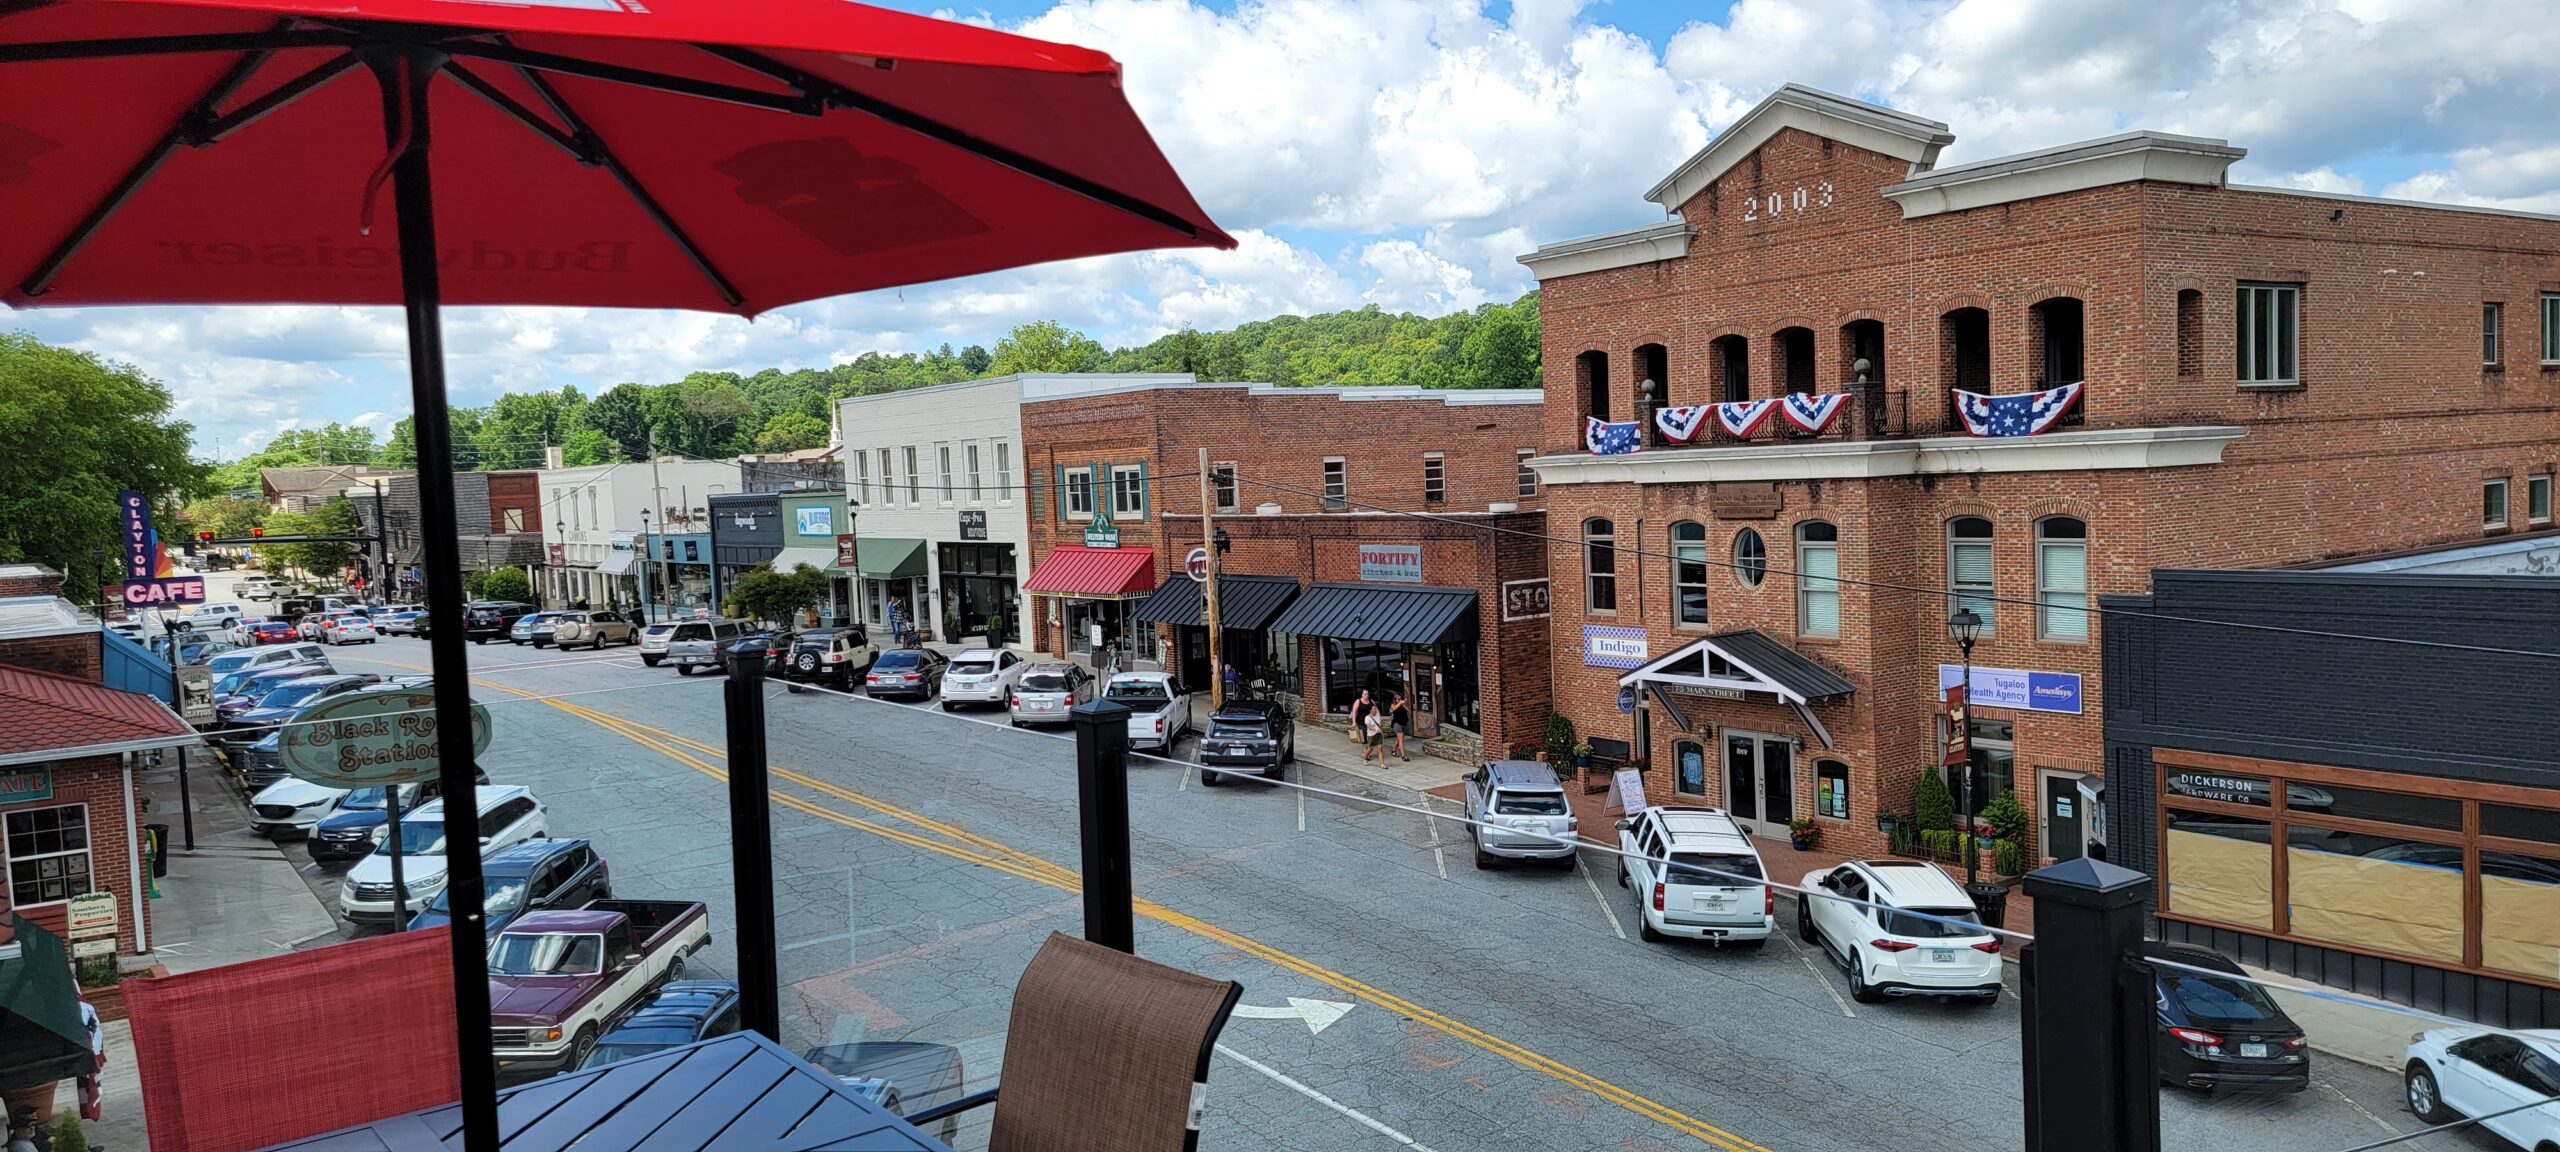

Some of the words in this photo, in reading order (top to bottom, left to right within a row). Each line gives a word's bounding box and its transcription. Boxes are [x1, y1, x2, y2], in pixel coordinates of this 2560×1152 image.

[1744, 181, 1833, 222] 2003
[129, 497, 146, 576] CLAYTON
[1361, 552, 1419, 565] FORTIFY
[126, 581, 203, 603] CAFE
[1599, 640, 1641, 656] Indigo
[1674, 685, 1685, 693] 75
[1686, 686, 1707, 696] MAIN
[1708, 688, 1742, 698] STREET
[1994, 677, 2026, 690] Tugaloo
[1996, 689, 2026, 702] Agency
[308, 716, 390, 747] Black
[2181, 773, 2252, 792] DICKERSON
